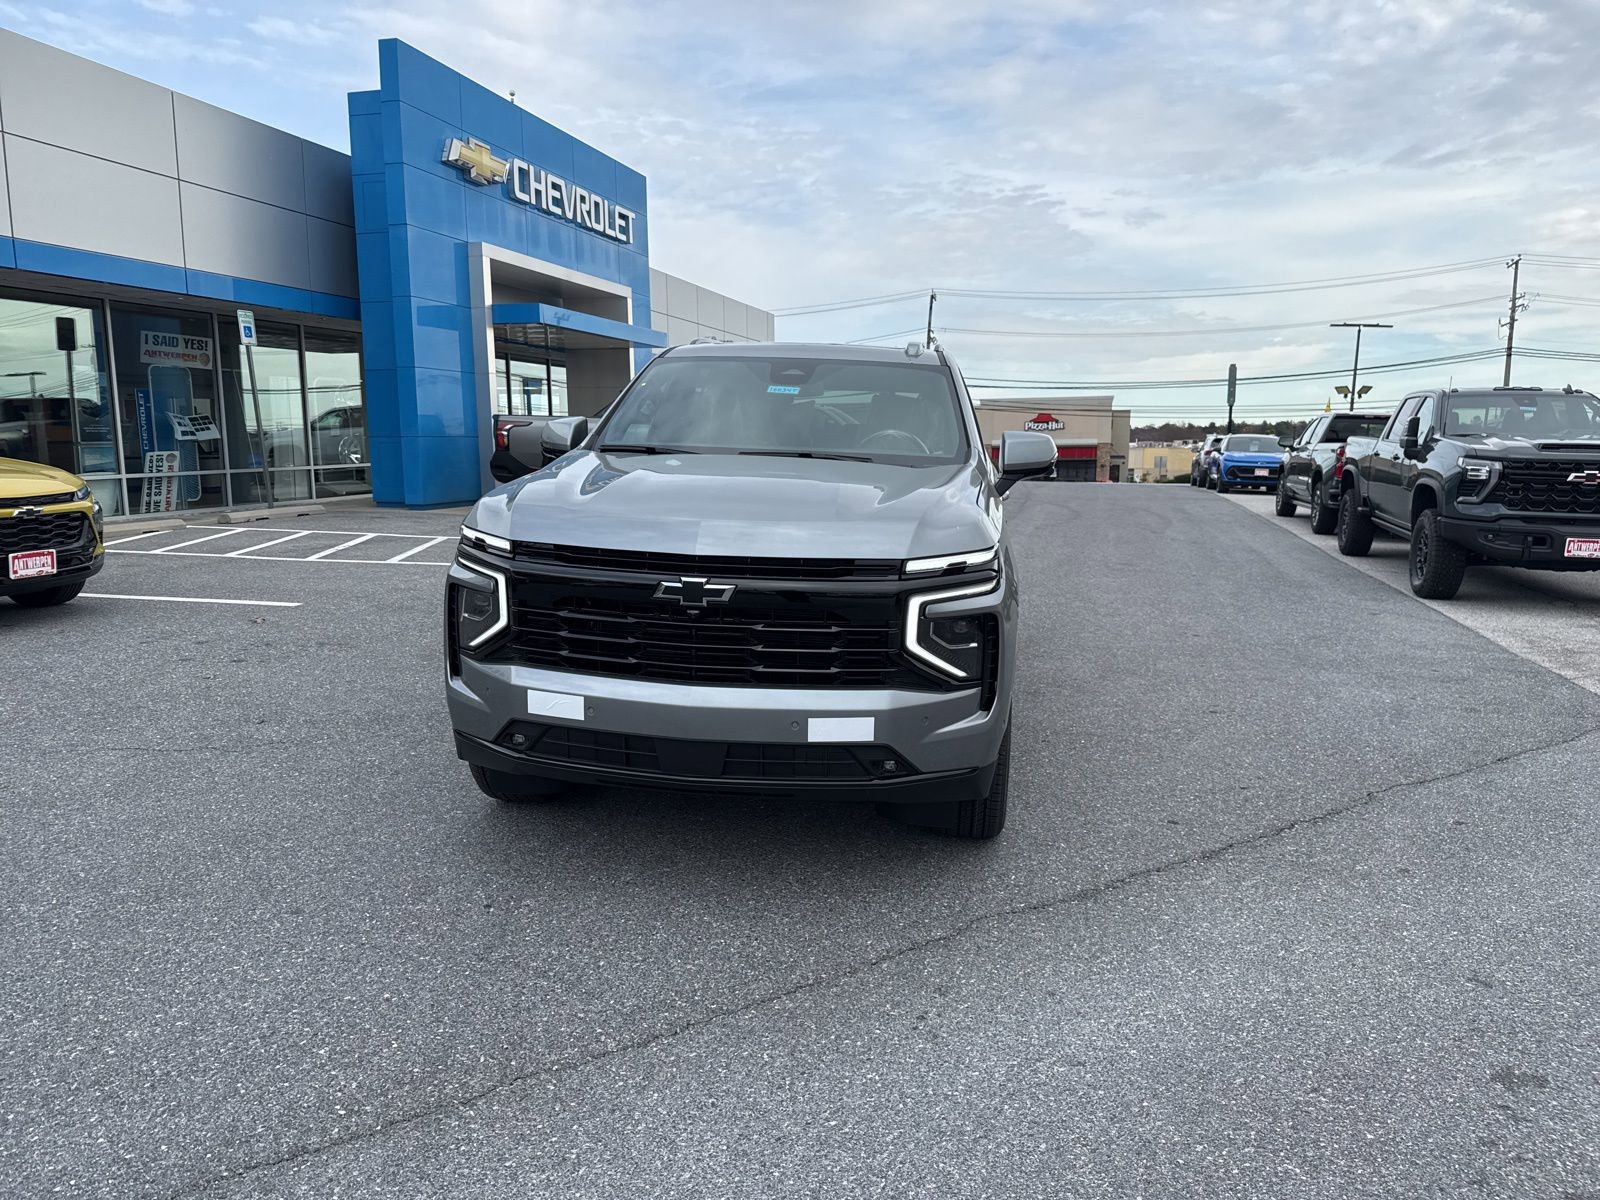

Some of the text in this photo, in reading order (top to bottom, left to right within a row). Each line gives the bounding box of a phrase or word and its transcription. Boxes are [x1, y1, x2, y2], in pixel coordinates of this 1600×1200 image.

[513, 158, 636, 244] CHEVROLET
[144, 333, 209, 351] I SAID YES!
[143, 349, 198, 363] ANTWERPEN
[138, 391, 149, 450] CHEVROLET
[1025, 421, 1064, 431] Pizza Hut
[153, 454, 164, 513] WE SAID YES!
[1568, 541, 1600, 553] ANTWERPE
[13, 555, 52, 571] ANTWERPEN
